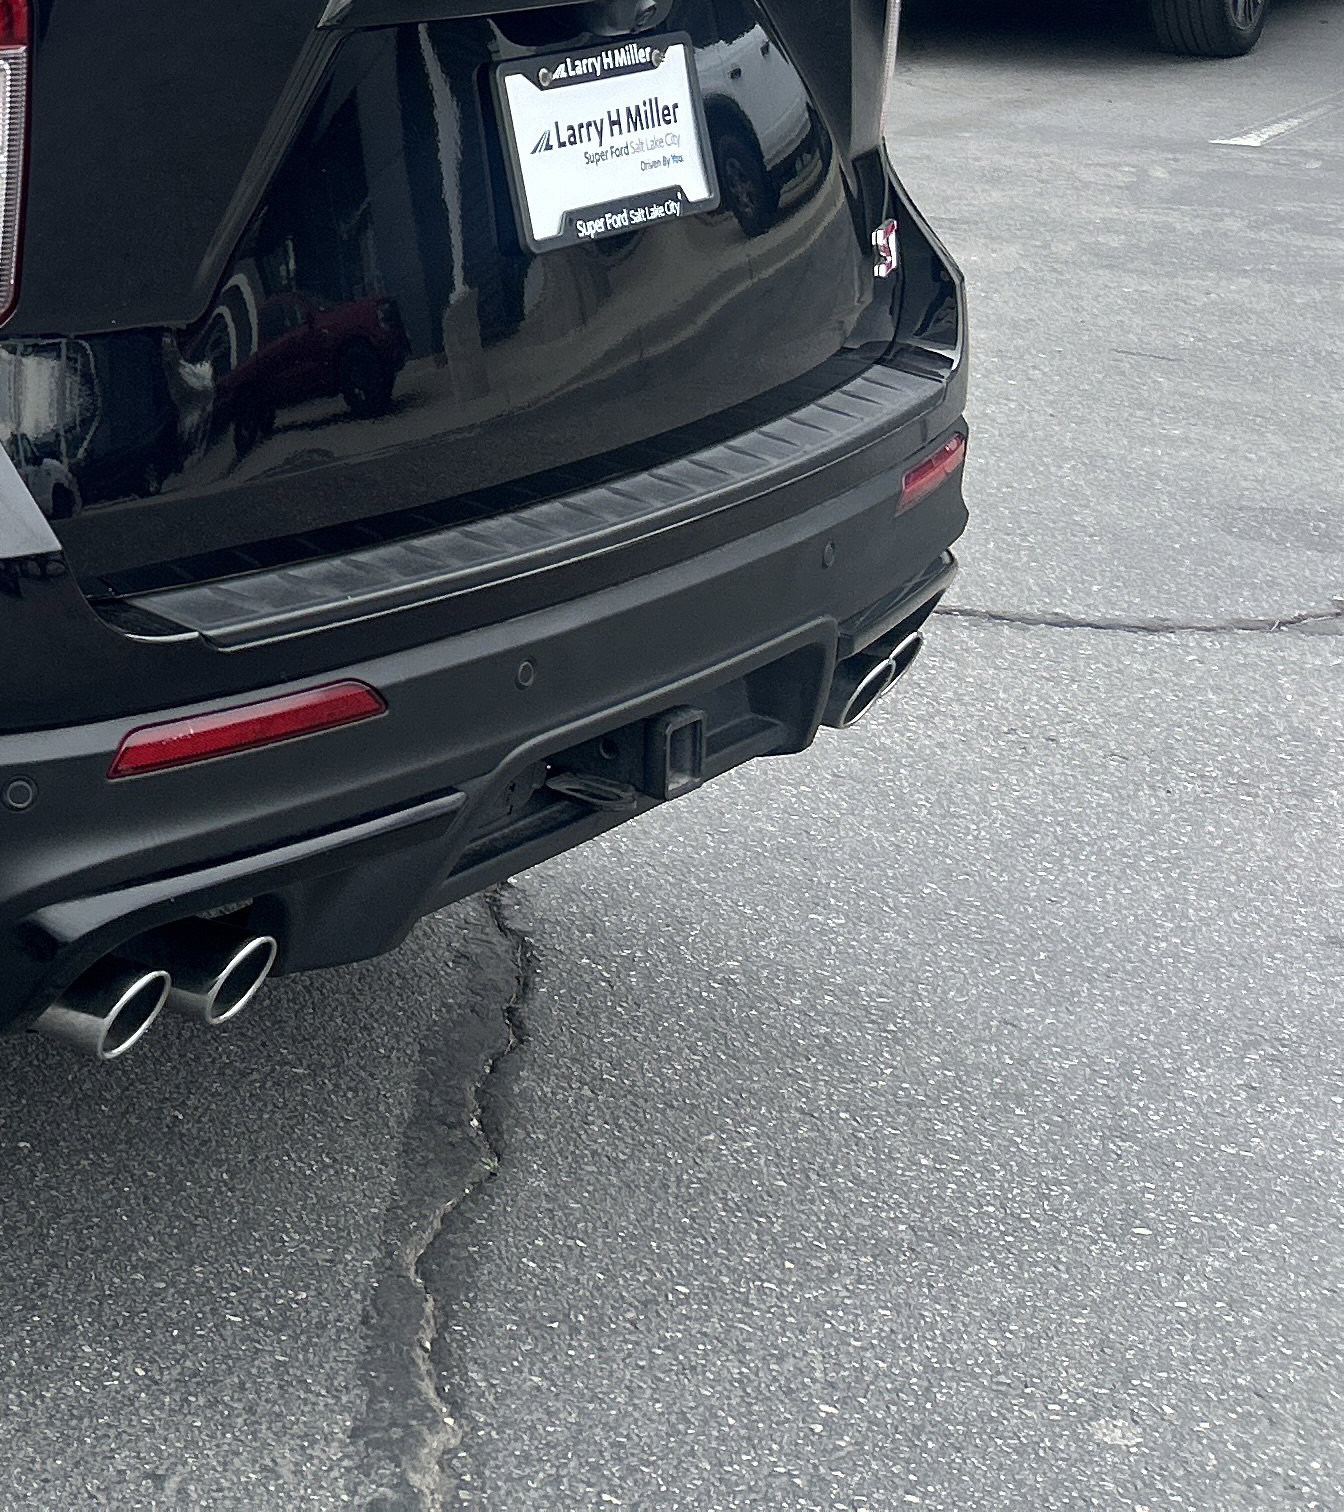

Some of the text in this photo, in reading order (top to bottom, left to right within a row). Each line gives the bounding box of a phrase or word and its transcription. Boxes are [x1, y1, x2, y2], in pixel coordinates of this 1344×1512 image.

[565, 43, 651, 77] Larry H Miller
[554, 97, 679, 148] Larry H Miller
[584, 150, 609, 166] Super
[610, 144, 630, 159] Ford
[576, 199, 680, 238] Super Ford Salt Lake City
